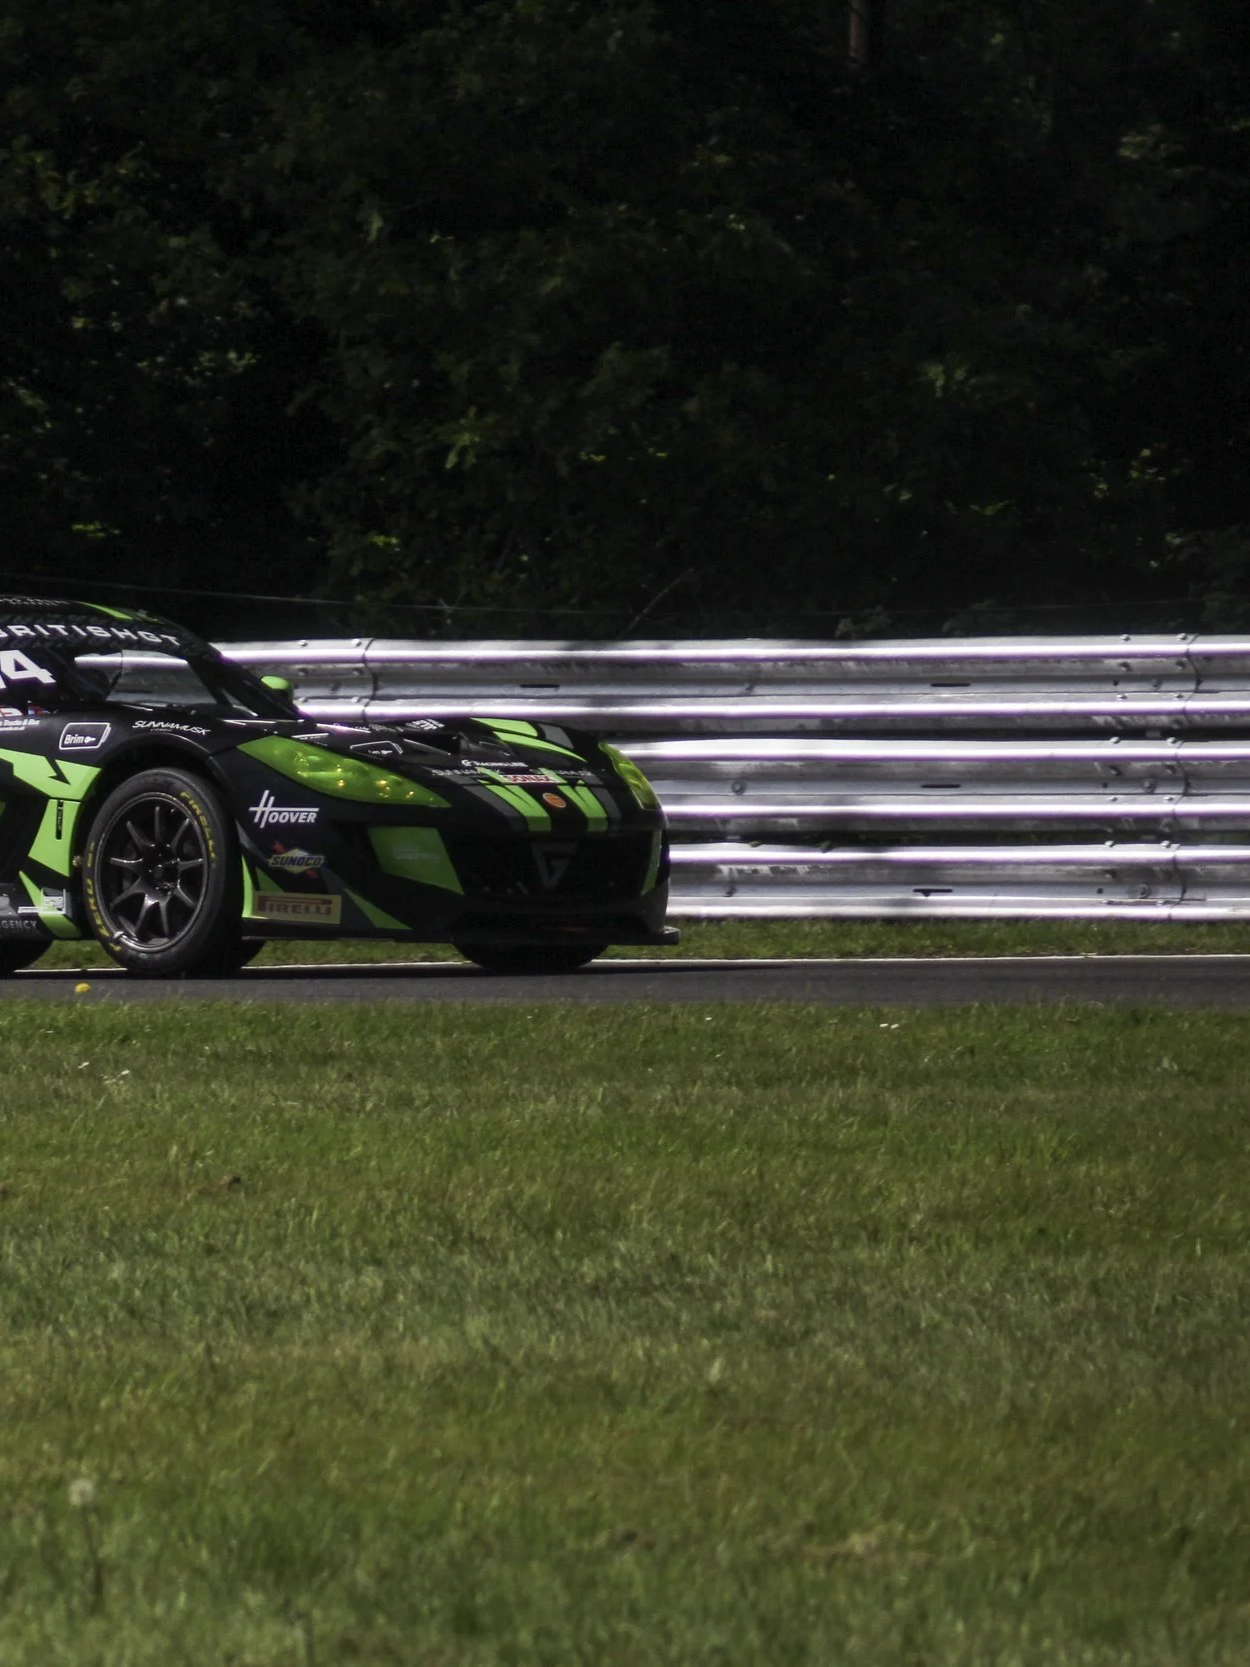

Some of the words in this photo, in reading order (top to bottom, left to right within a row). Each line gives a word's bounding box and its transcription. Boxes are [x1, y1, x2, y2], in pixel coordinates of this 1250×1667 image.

[64, 734, 84, 745] Brim
[249, 790, 320, 828] HOOVER
[270, 855, 323, 867] SUNOCO
[258, 895, 332, 916] PIRELLI
